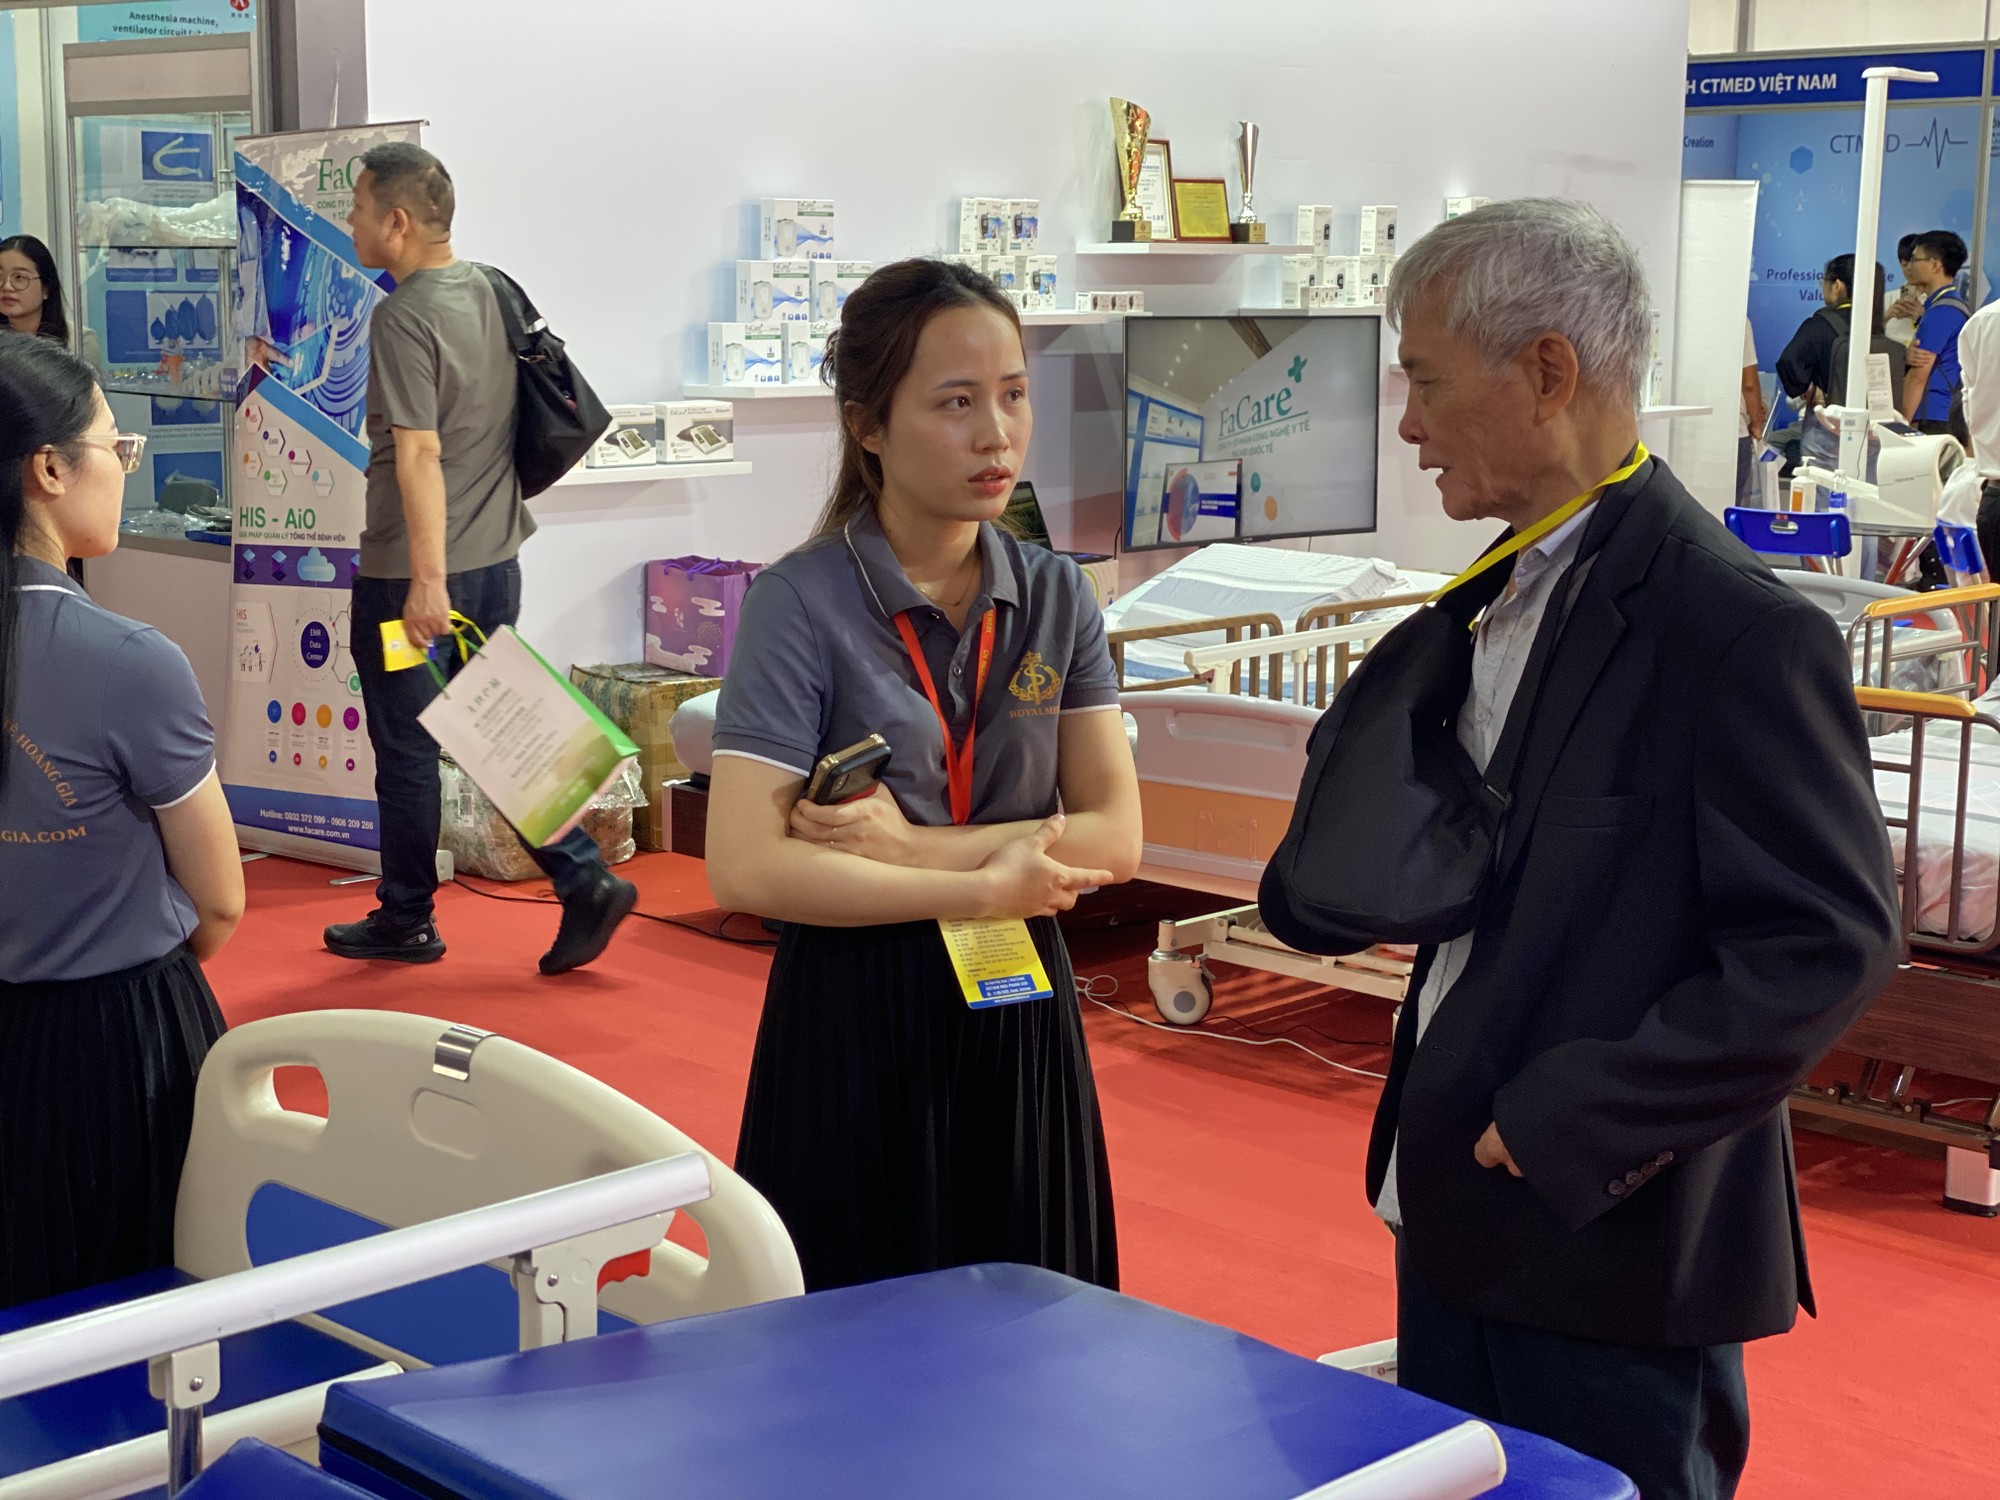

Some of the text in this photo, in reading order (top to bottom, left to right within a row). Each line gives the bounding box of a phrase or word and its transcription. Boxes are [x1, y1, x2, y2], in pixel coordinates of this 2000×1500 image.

[129, 11, 219, 27] Anesthesia machine,
[113, 25, 157, 34] ventilator
[159, 27, 187, 36] circuit
[1700, 77, 1756, 94] CTMED
[1759, 72, 1794, 95] VIỆT
[1797, 74, 1837, 90] NAM
[1684, 136, 1714, 148] Creation
[1766, 268, 1824, 281] Professio
[1219, 387, 1292, 437] FaCare
[239, 506, 266, 528] HIS
[284, 508, 316, 530] AiO
[236, 609, 247, 620] HIS
[56, 782, 78, 807] GIA
[260, 808, 284, 820] Hotline:
